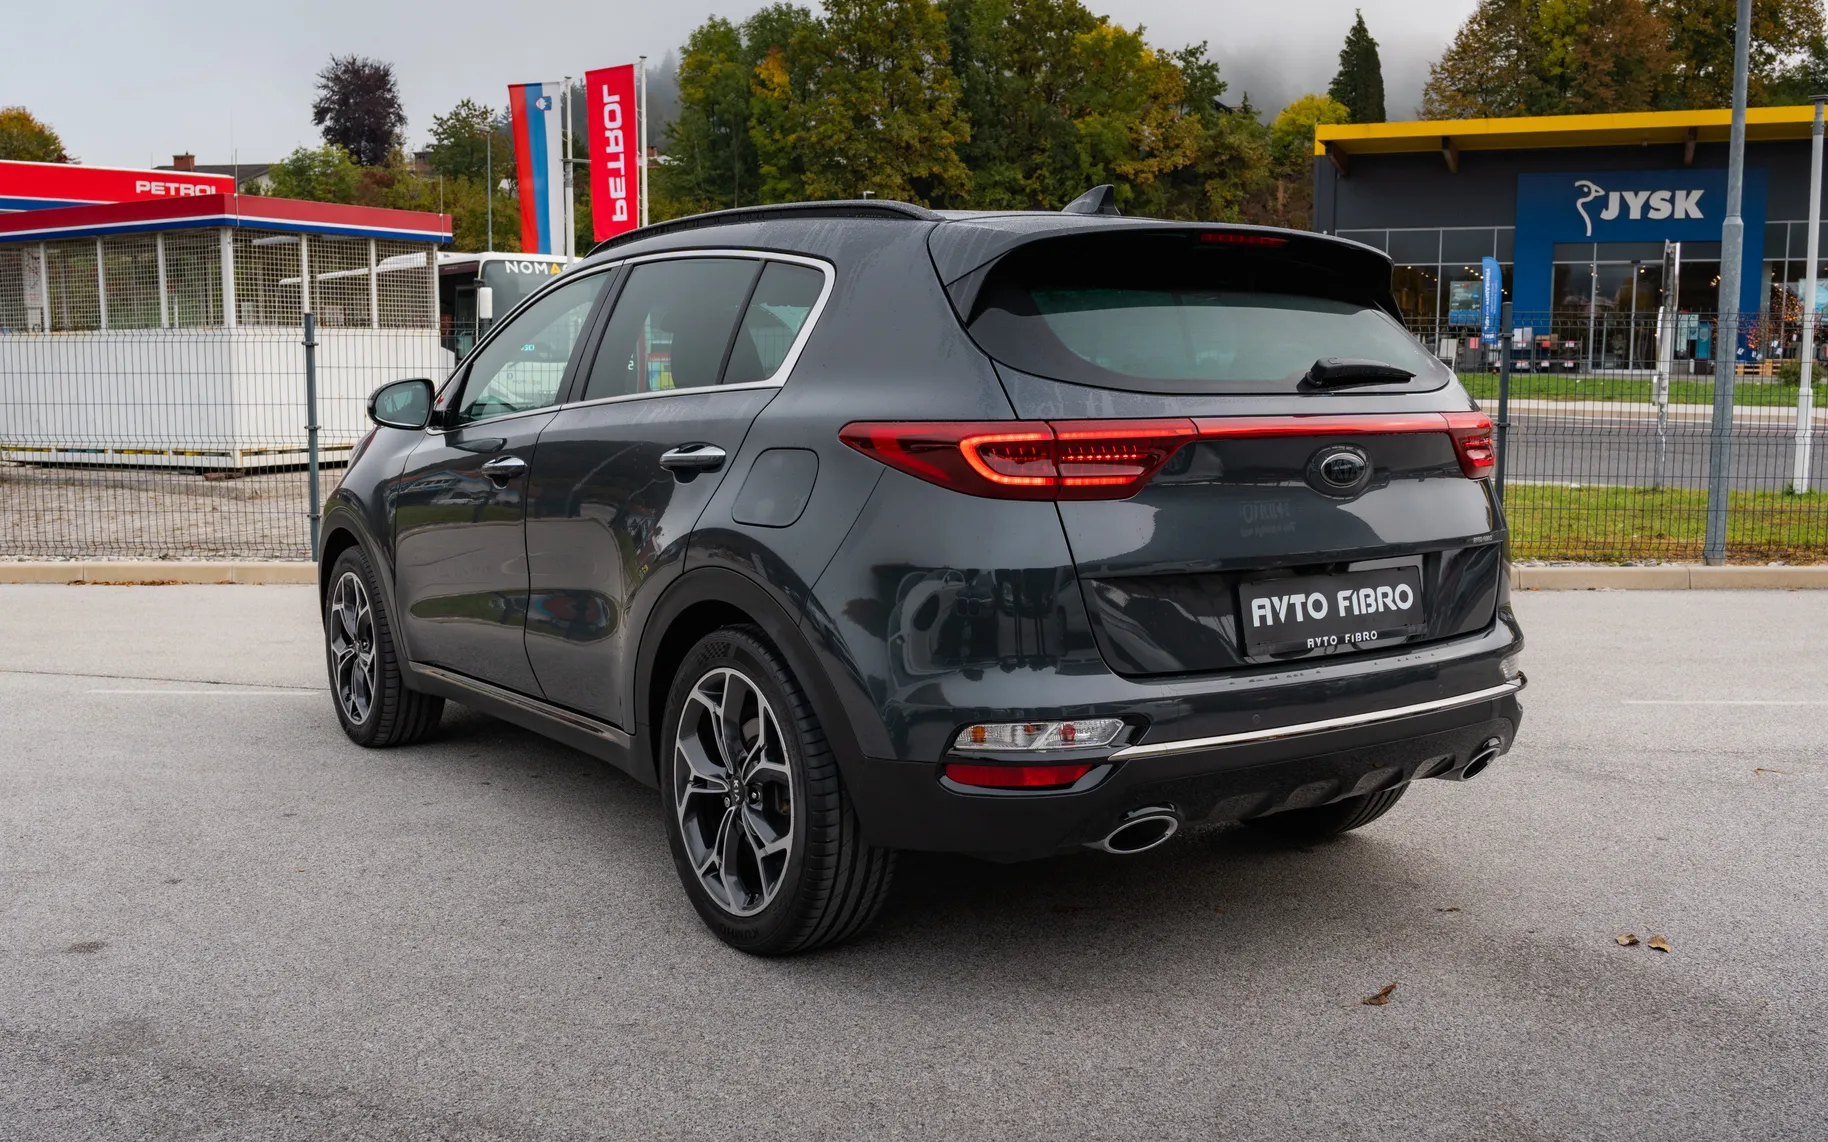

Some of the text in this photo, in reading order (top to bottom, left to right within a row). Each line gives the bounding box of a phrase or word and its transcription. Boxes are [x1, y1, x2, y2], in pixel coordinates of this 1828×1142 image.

[1600, 189, 1704, 220] JYSK
[504, 261, 567, 275] NOMA
[1251, 583, 1414, 627] AVTO FIBRO
[1307, 630, 1378, 648] AVTO FIBRO
